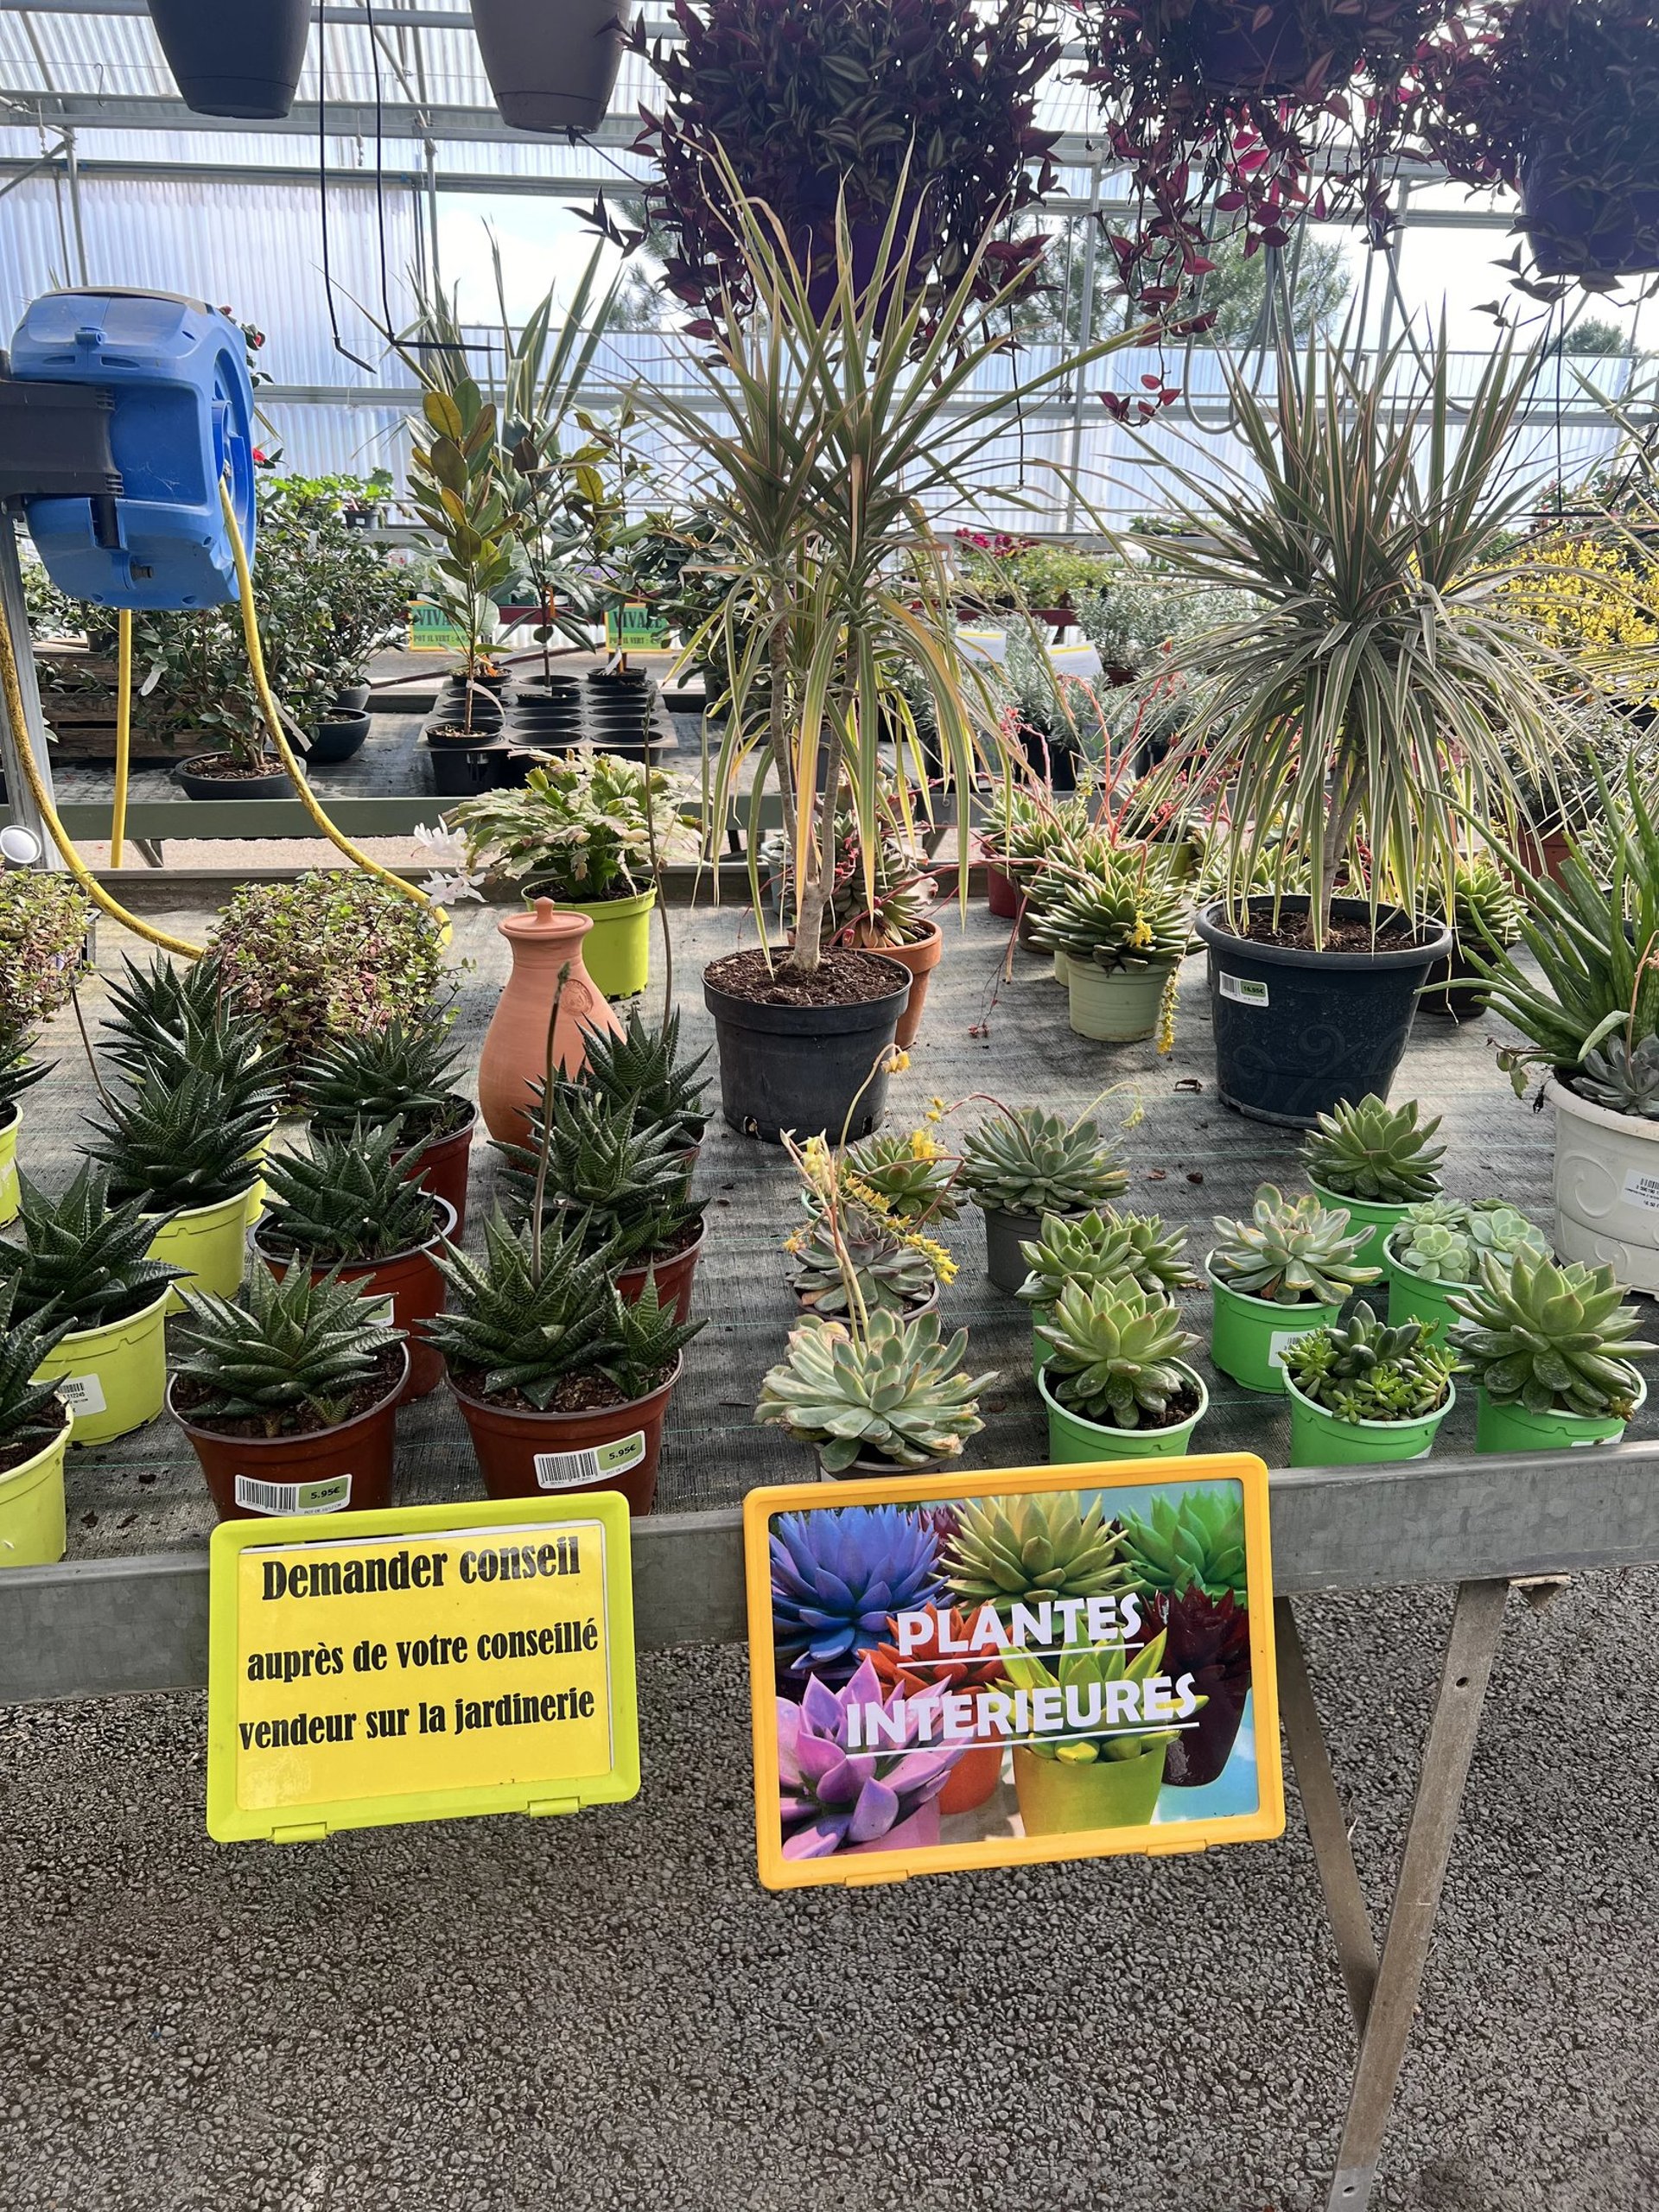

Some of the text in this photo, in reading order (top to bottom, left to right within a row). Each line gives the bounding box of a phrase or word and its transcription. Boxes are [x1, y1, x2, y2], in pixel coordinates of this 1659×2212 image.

[608, 1443, 637, 1460] 5.95€
[310, 1485, 341, 1500] 5.95€
[261, 1535, 581, 1601] Demander conseil
[247, 1618, 598, 1683] auprès de votre conseillé
[896, 1592, 1143, 1656] PLANTES
[238, 1687, 595, 1751] vendeur sur la jardinerie
[846, 1672, 1198, 1748] INTERIEURES
